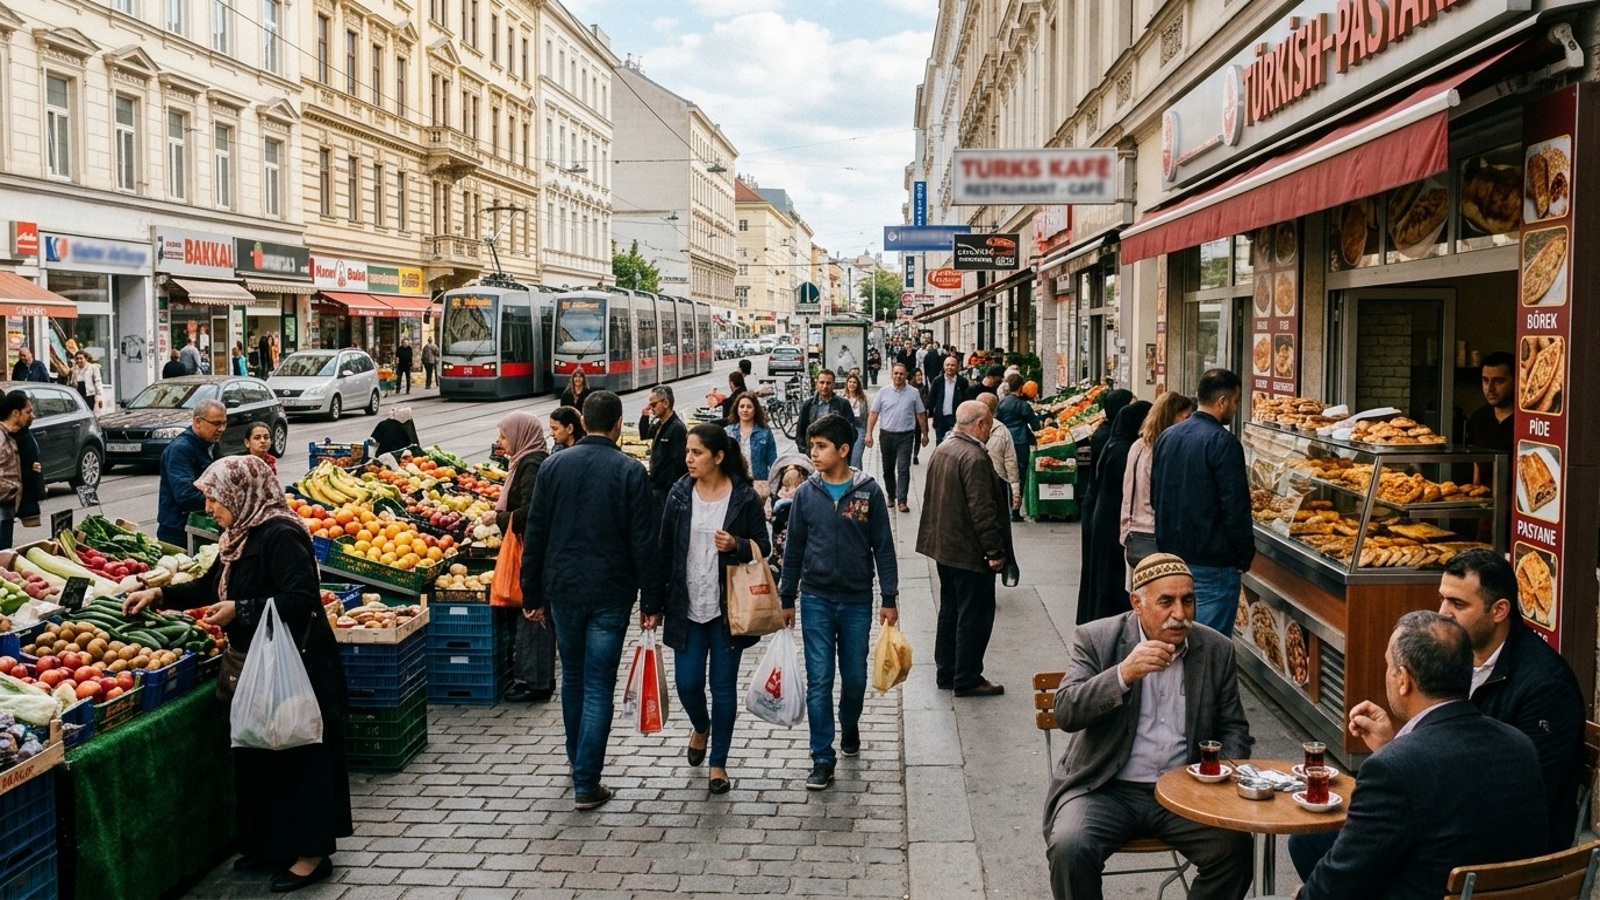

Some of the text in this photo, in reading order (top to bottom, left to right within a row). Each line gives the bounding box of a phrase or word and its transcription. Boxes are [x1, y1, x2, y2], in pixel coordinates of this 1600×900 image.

[965, 183, 1056, 195] RESTAURANT
[185, 238, 234, 268] BAKKAL
[1517, 520, 1556, 546] PASTANE
